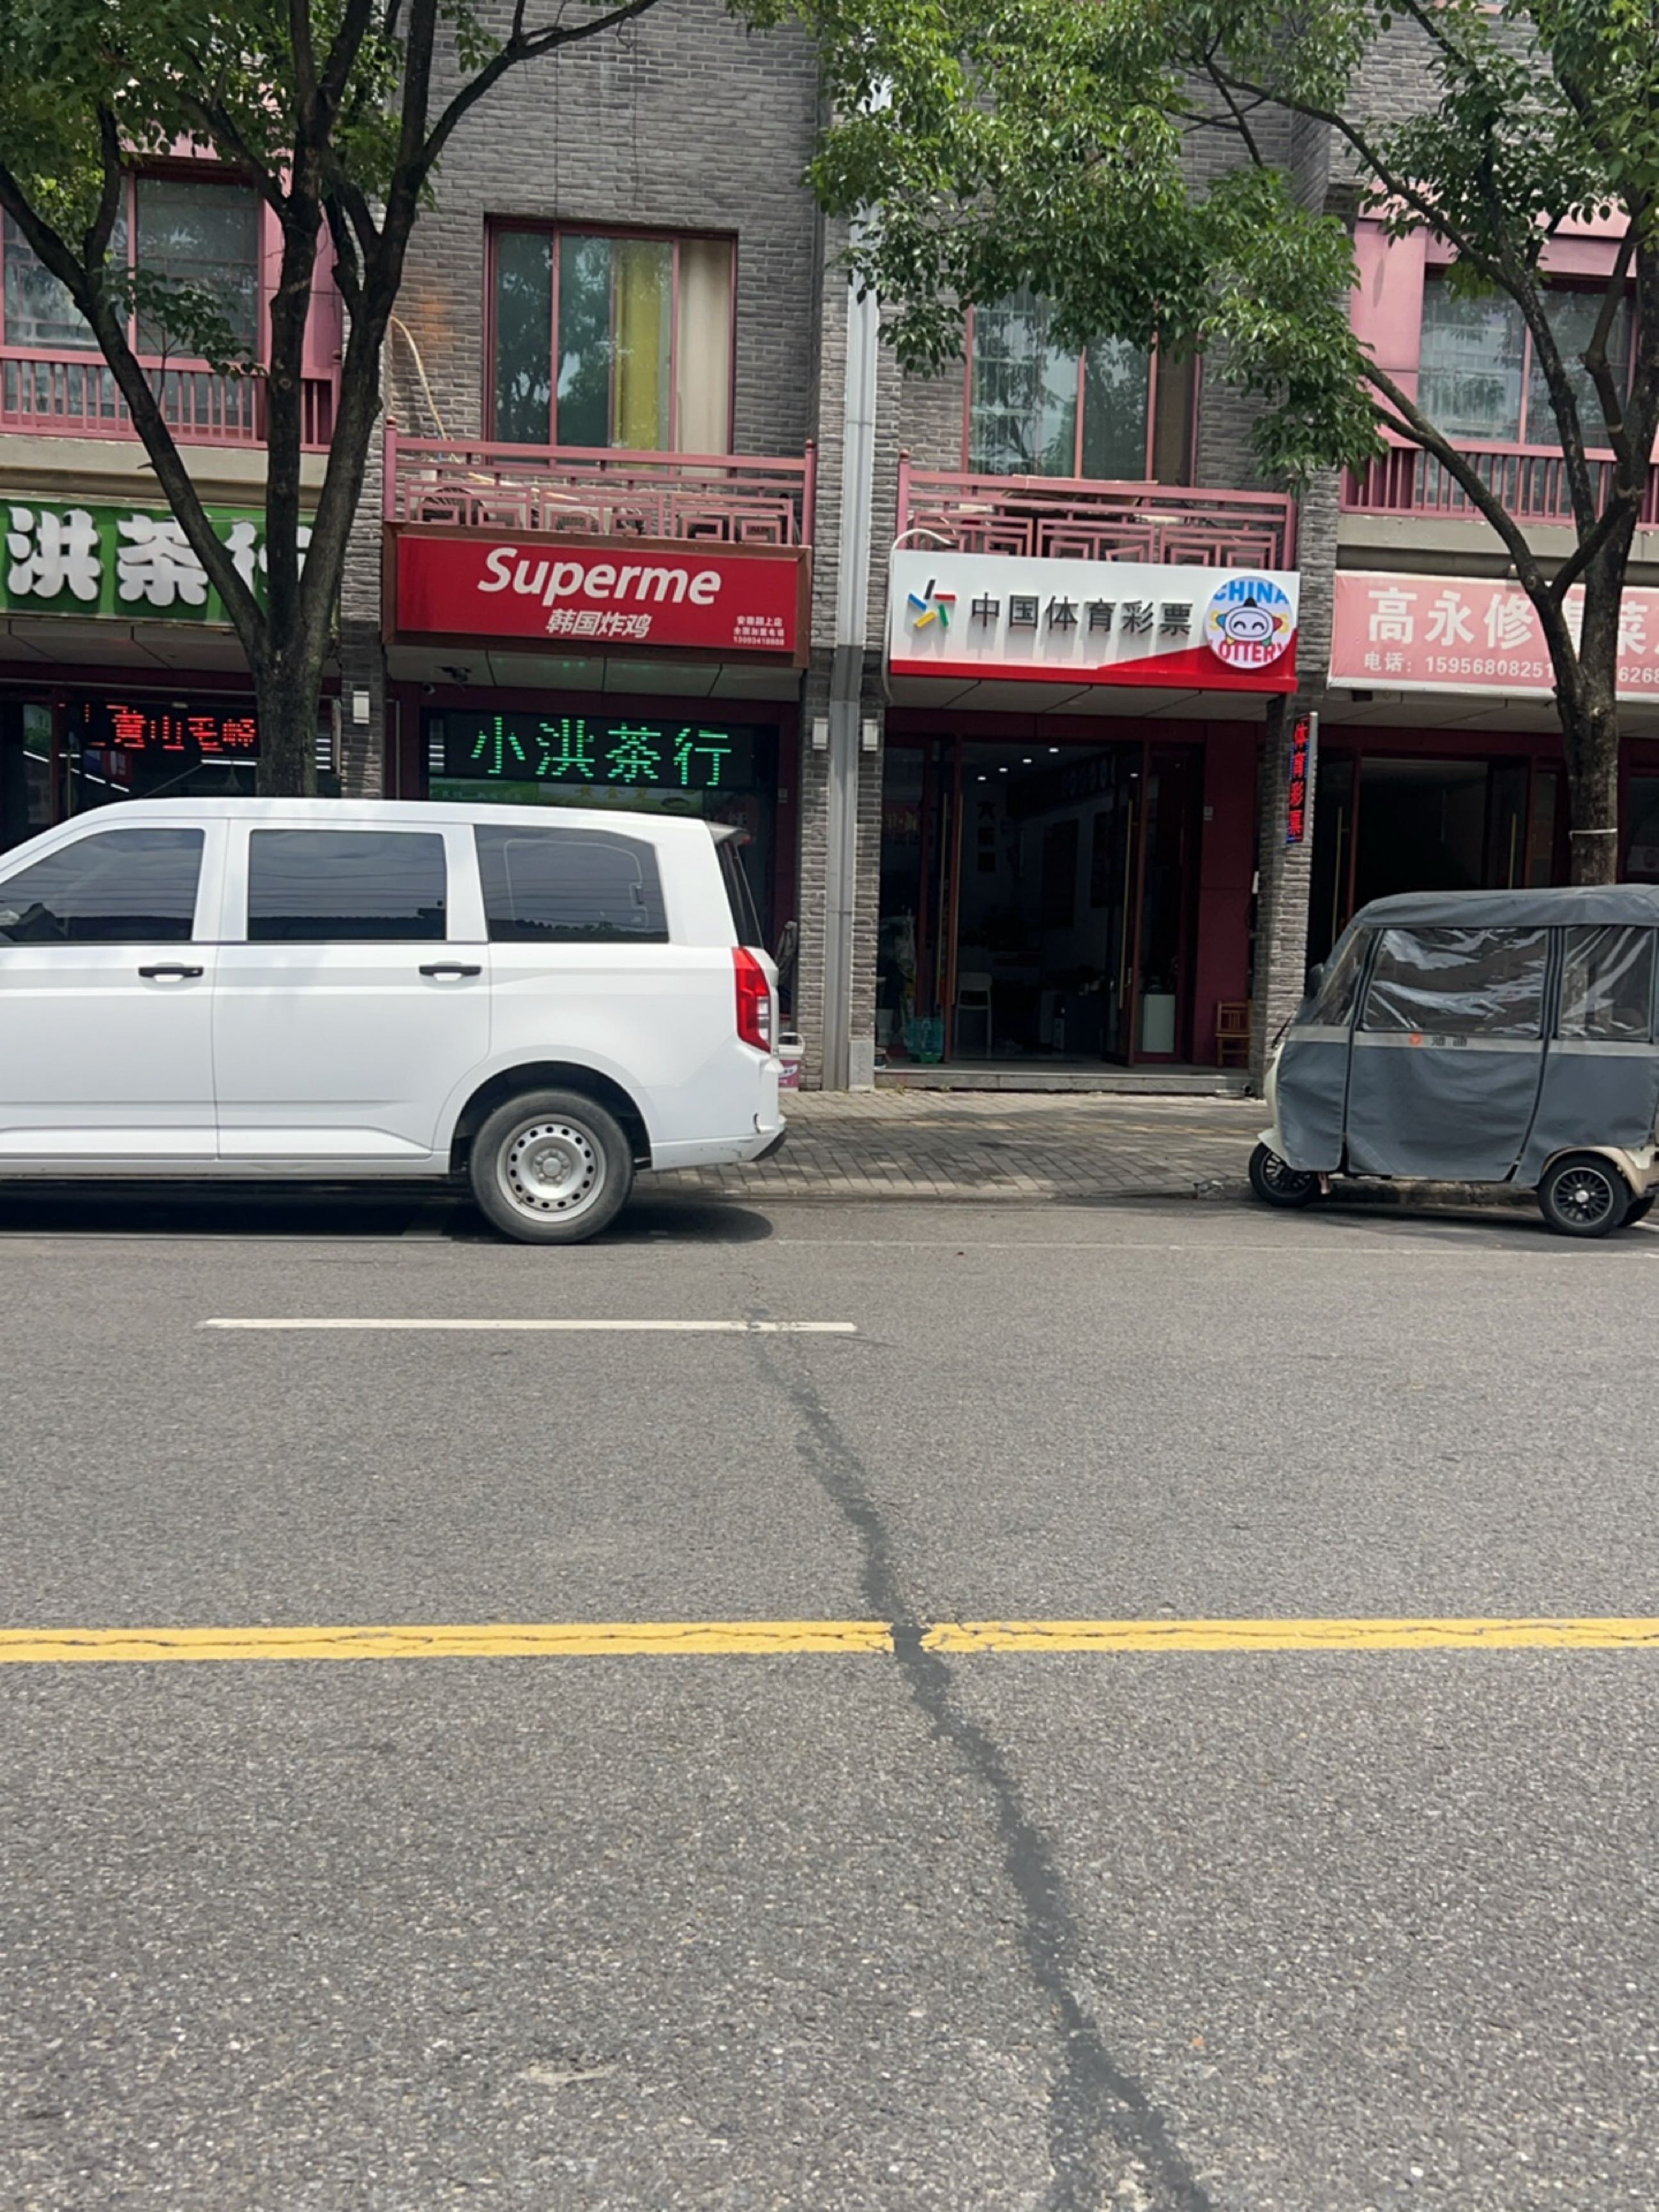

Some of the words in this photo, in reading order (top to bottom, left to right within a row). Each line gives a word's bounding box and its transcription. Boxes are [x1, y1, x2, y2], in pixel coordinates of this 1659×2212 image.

[477, 547, 721, 606] Superme
[1214, 580, 1290, 604] CHINA
[545, 609, 652, 638] 韩国炸鸡
[971, 591, 1193, 636] 中国体育彩票
[1368, 587, 1659, 655] 高永修菜
[1208, 639, 1286, 662] OTTER
[470, 716, 732, 785] 小洪茶行
